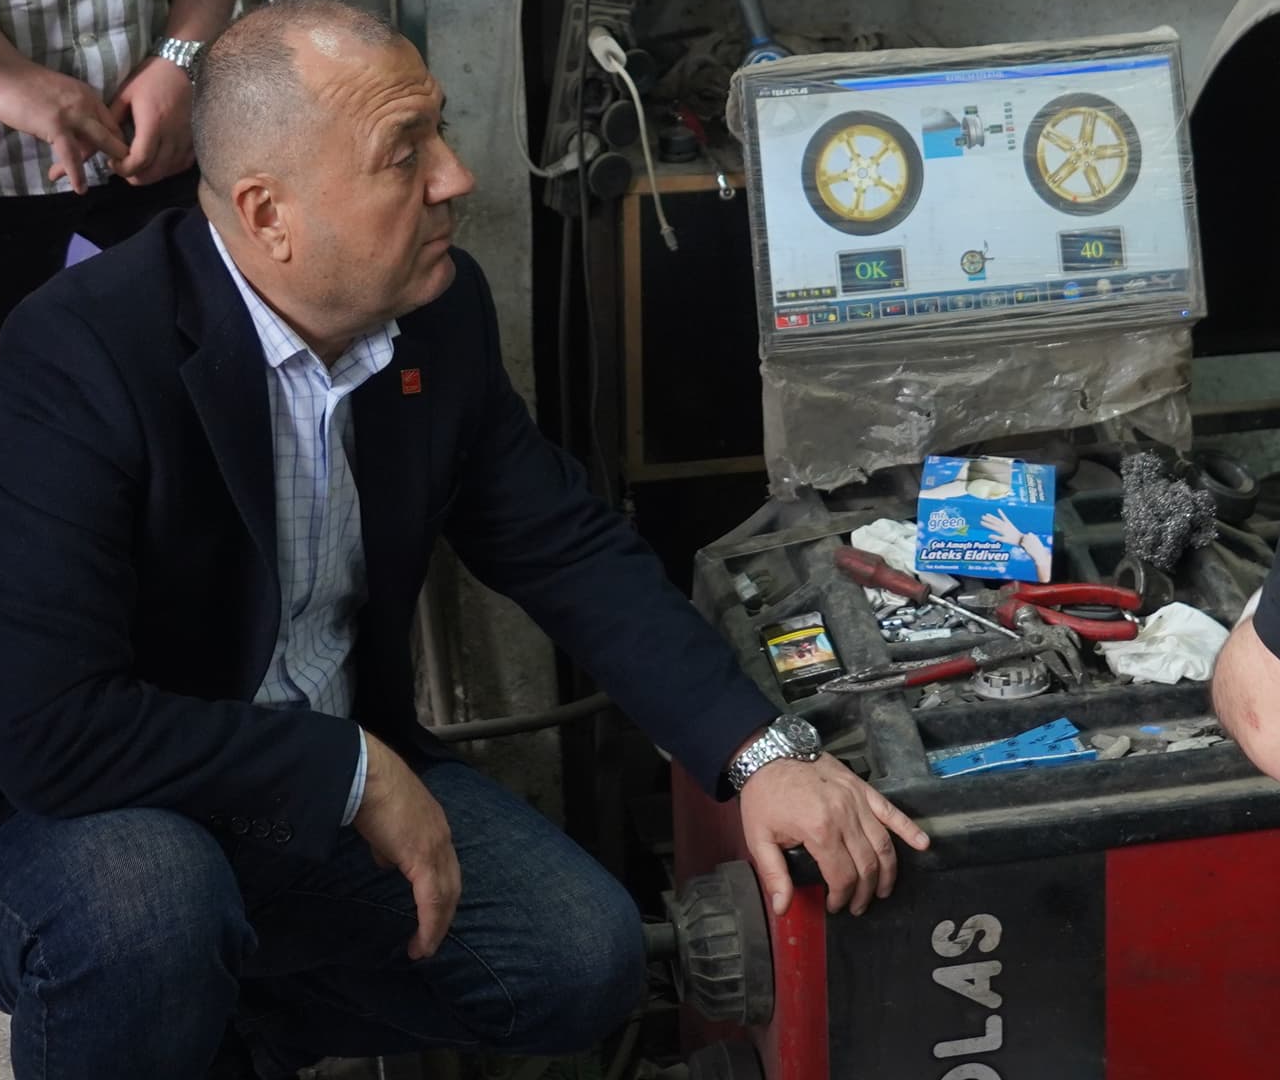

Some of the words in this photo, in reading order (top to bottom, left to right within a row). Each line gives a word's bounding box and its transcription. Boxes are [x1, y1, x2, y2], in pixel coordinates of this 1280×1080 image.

[1080, 240, 1104, 258] 40
[855, 260, 888, 280] OK
[928, 518, 965, 530] green
[921, 550, 963, 561] Lateks
[964, 551, 1009, 561] Eldiven
